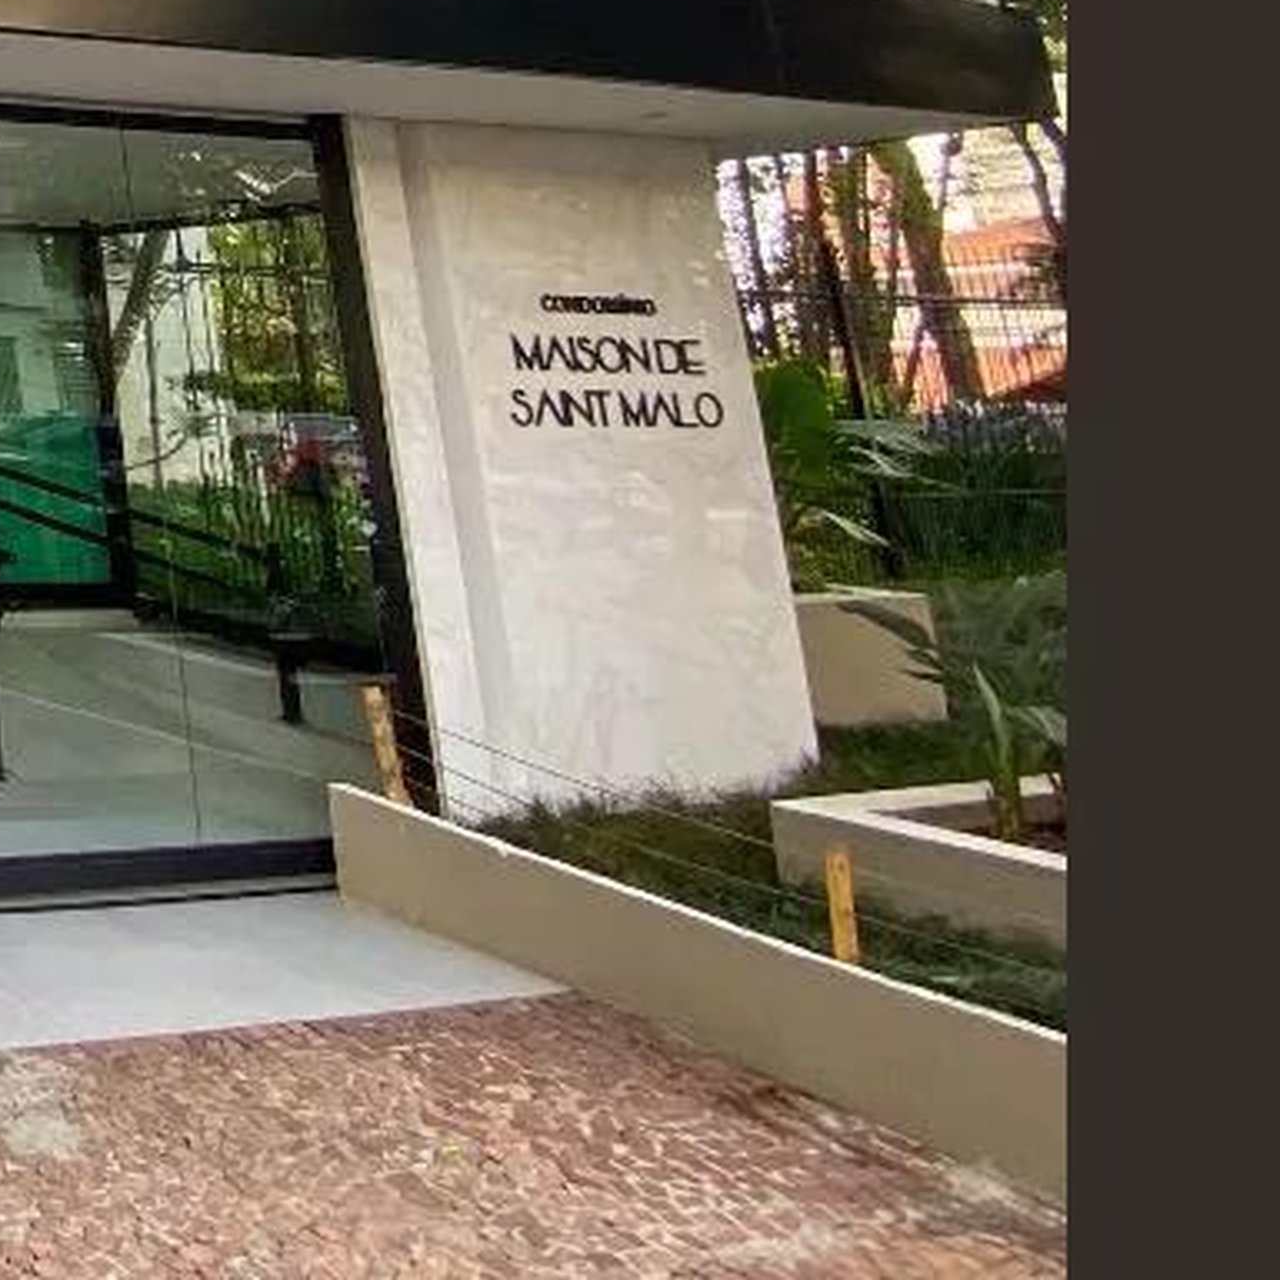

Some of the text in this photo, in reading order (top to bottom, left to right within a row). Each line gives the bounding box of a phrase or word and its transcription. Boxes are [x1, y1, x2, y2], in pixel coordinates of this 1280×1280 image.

[511, 334, 706, 375] MAISON DE
[510, 389, 724, 428] SAINT MALO
